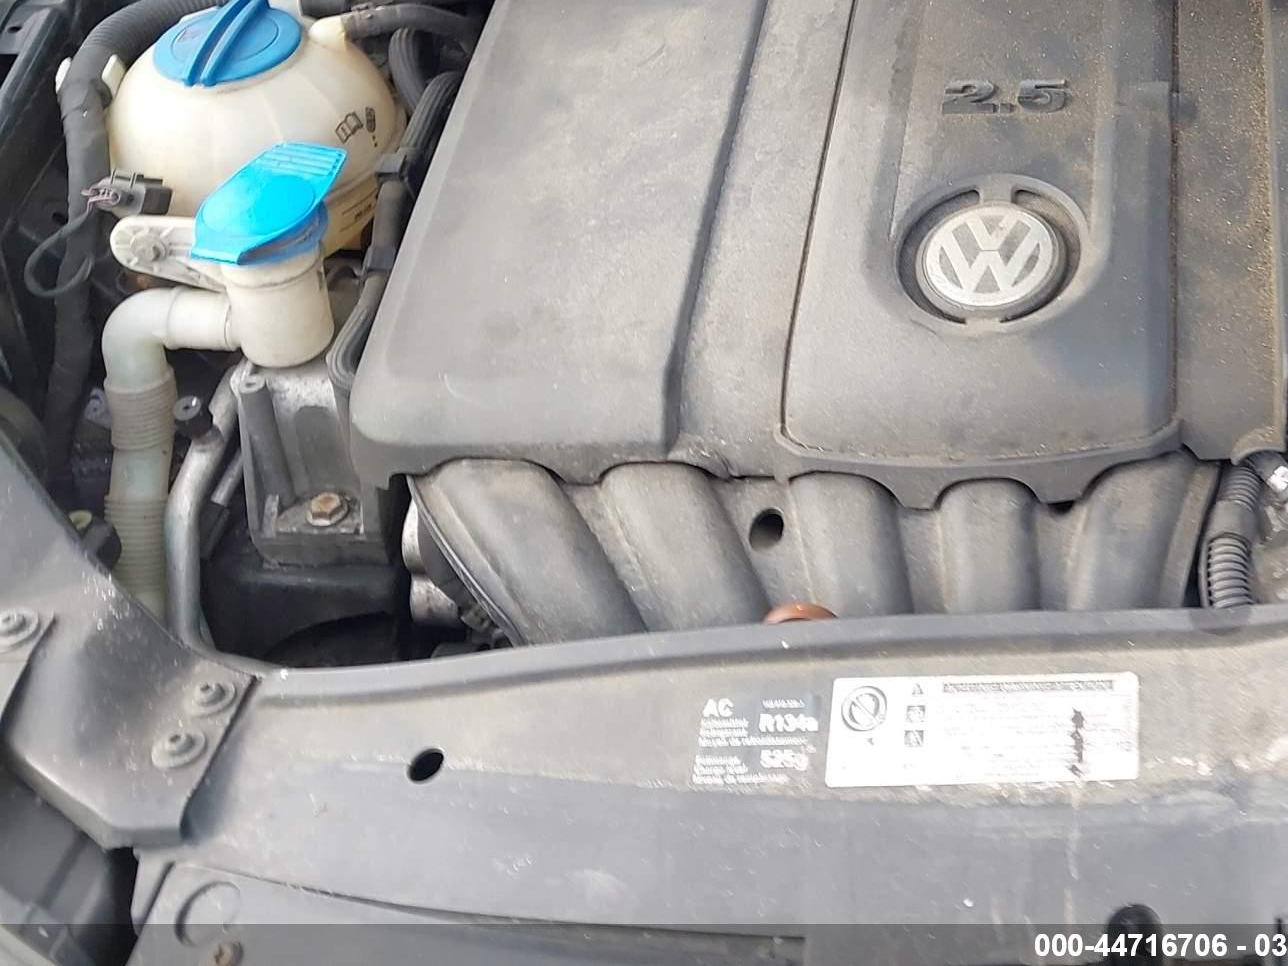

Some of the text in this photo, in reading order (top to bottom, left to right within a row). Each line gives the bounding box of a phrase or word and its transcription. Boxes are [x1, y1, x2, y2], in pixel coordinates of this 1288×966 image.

[942, 79, 1068, 114] 2.5
[926, 206, 1054, 306] VW
[702, 698, 734, 717] AC
